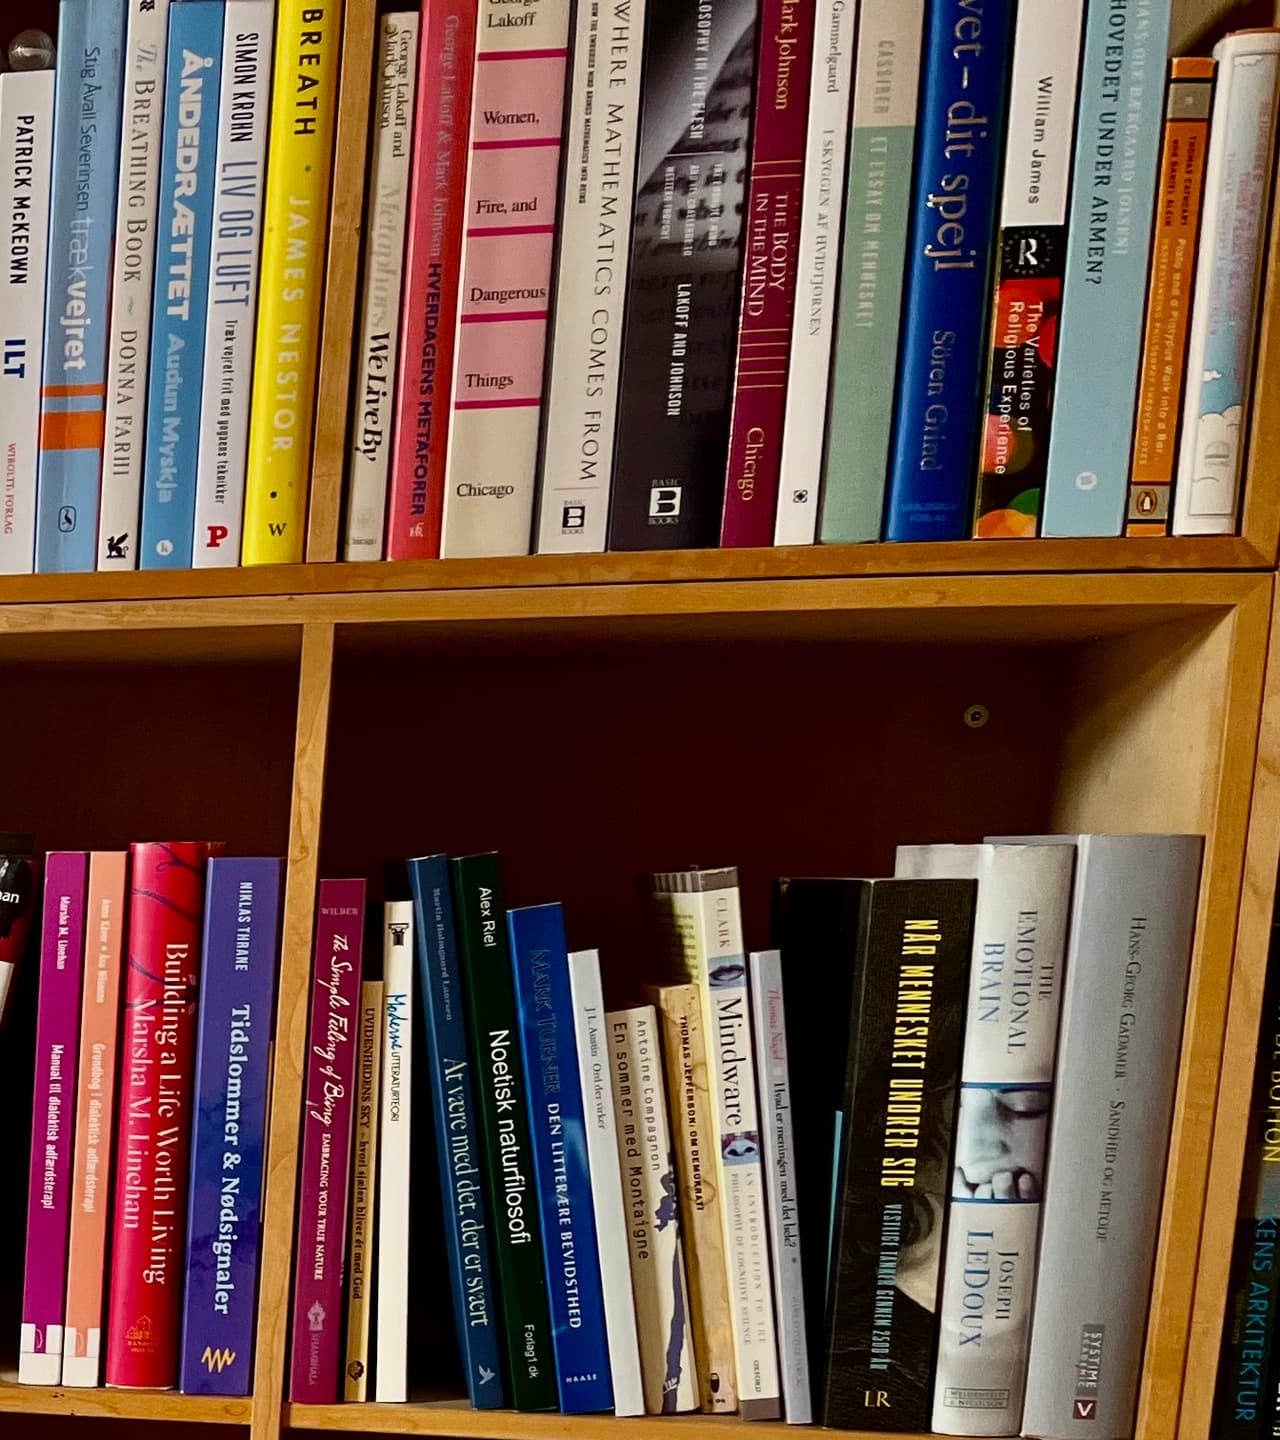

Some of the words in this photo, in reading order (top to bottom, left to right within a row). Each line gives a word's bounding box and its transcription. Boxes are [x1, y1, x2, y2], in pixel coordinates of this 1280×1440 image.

[487, 11, 536, 29] Lakoff
[293, 8, 323, 138] BREATH
[483, 108, 540, 128] Women,
[944, 99, 988, 160] dit
[1035, 77, 1053, 140] William
[13, 114, 34, 191] PATRICK
[168, 48, 212, 322] ÅNDEDRÆTTET
[221, 161, 257, 197] LIV
[1027, 149, 1047, 204] James
[9, 197, 31, 285] McKEOWN
[220, 205, 253, 237] OG
[475, 198, 508, 216] Fire,
[511, 198, 538, 213] and
[925, 179, 975, 271] spejl
[214, 251, 250, 307] LUFT
[281, 196, 310, 303] JAMES
[470, 285, 547, 304] Dangerous
[3, 338, 27, 379] ILT
[422, 262, 442, 396] HVERDAGENS
[272, 322, 304, 453] NESTOR
[465, 371, 514, 390] Things
[411, 401, 433, 516] METAFORER
[457, 481, 514, 500] Chicago
[479, 887, 492, 917] Alex
[482, 921, 495, 947] Riel
[904, 919, 938, 956] NÅR
[155, 943, 189, 1044] Building
[978, 943, 1005, 1023] BRAIN
[1007, 910, 1038, 1054] EMOTIONAL
[891, 966, 935, 1070] MENNESKET
[227, 1005, 252, 1145] Tidslommer
[489, 1030, 514, 1111] Noetisk
[716, 997, 748, 1126] Mindware
[158, 1074, 182, 1121] Life
[884, 1080, 926, 1148] UNDER
[153, 1127, 180, 1201] Worth
[223, 1152, 241, 1171] &
[498, 1118, 531, 1243] naturfilosofi
[881, 1157, 917, 1187] SIG
[143, 1206, 175, 1284] Living
[213, 1178, 240, 1314] Nødsignaler
[864, 1390, 890, 1408] LR
